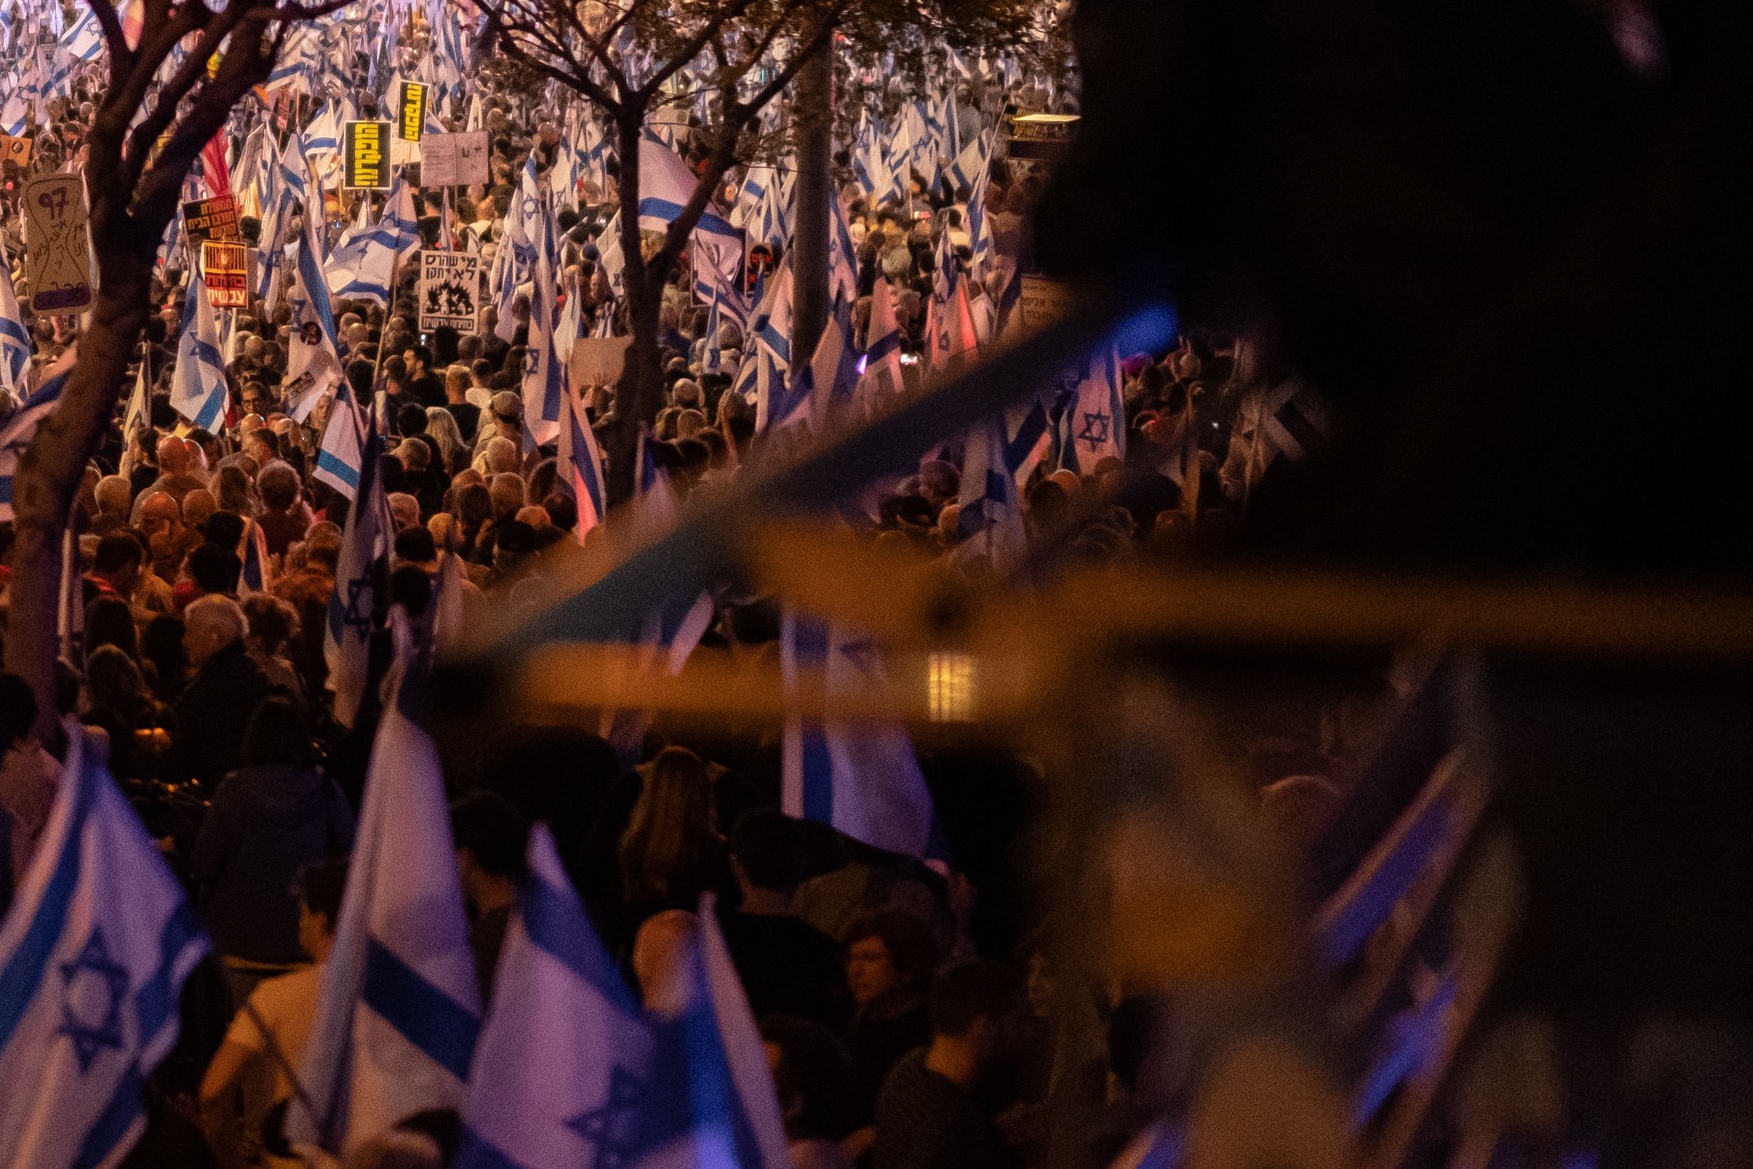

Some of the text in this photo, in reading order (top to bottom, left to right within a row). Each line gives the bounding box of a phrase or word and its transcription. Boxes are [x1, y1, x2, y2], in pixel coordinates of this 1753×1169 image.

[354, 123, 382, 187] הופקרנו!
[38, 186, 69, 220] 97
[425, 254, 477, 268] מי שהרס
[453, 268, 475, 280] לא
[206, 289, 246, 305] עכשיו
